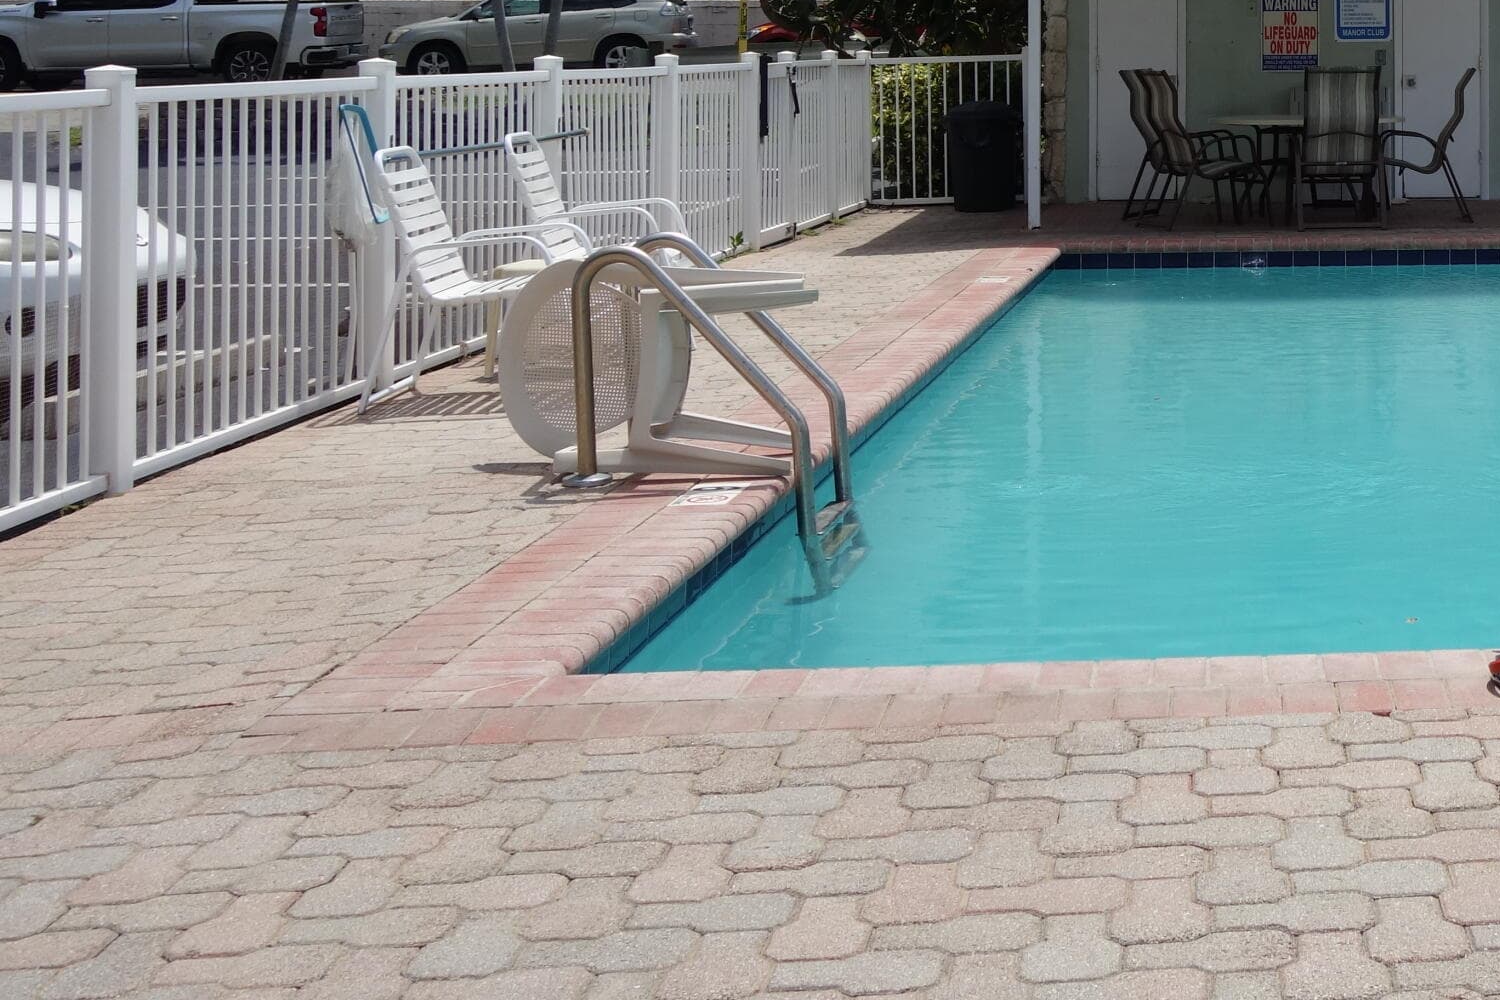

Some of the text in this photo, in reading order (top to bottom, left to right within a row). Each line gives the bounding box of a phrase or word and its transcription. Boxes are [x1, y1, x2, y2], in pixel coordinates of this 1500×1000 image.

[1284, 12, 1297, 26] NO
[1264, 26, 1317, 40] LIFEGUARD
[1270, 40, 1311, 54] ON DUTY
